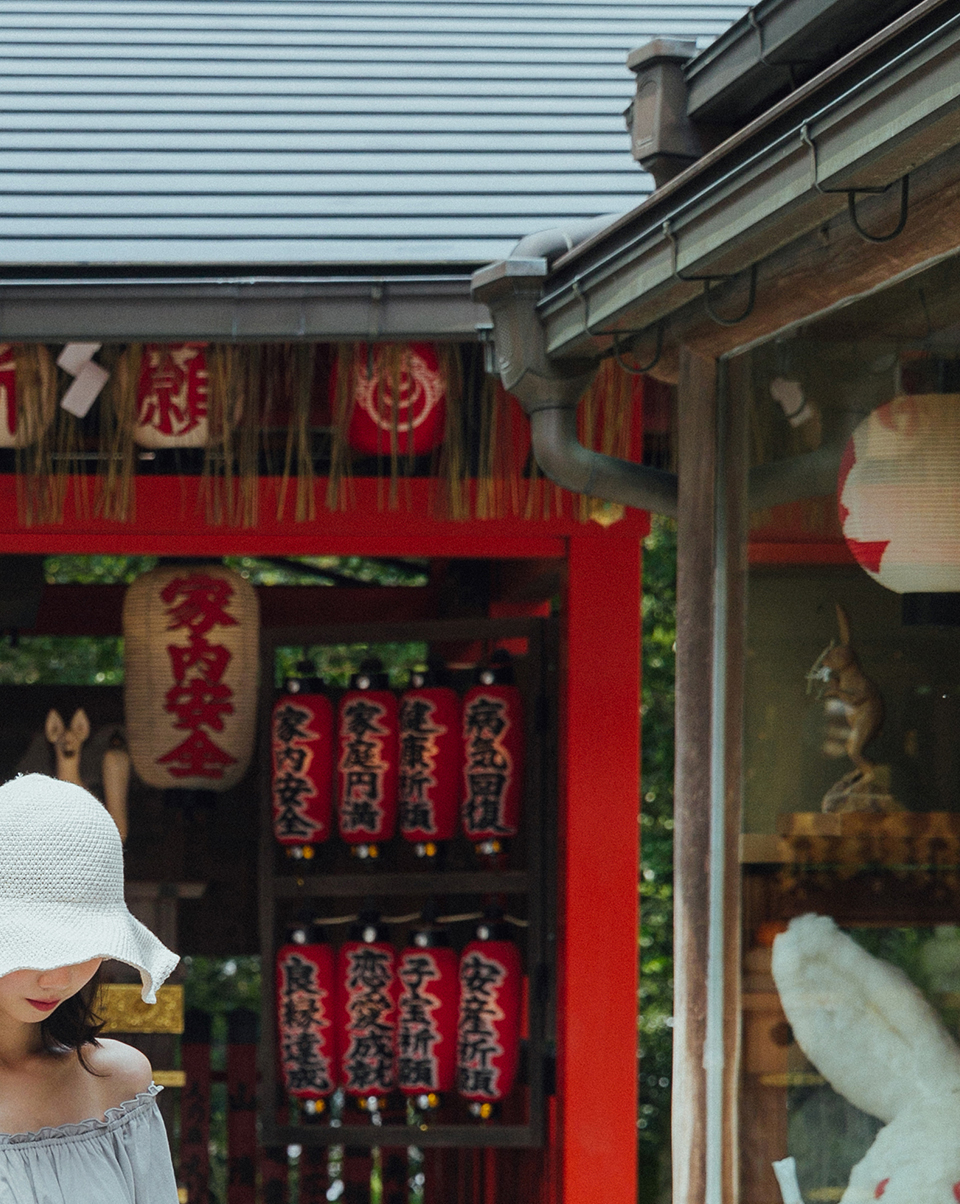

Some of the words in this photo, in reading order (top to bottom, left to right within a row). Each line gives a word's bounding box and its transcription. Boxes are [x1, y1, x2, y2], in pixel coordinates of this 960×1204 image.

[156, 573, 239, 780] 家内安全
[275, 704, 321, 837] 家内安全
[342, 701, 386, 832] 家庭円満
[346, 951, 393, 1089] 恋愛成就
[398, 956, 438, 1087] 子宝祈願
[457, 955, 504, 1096] 安産祈願
